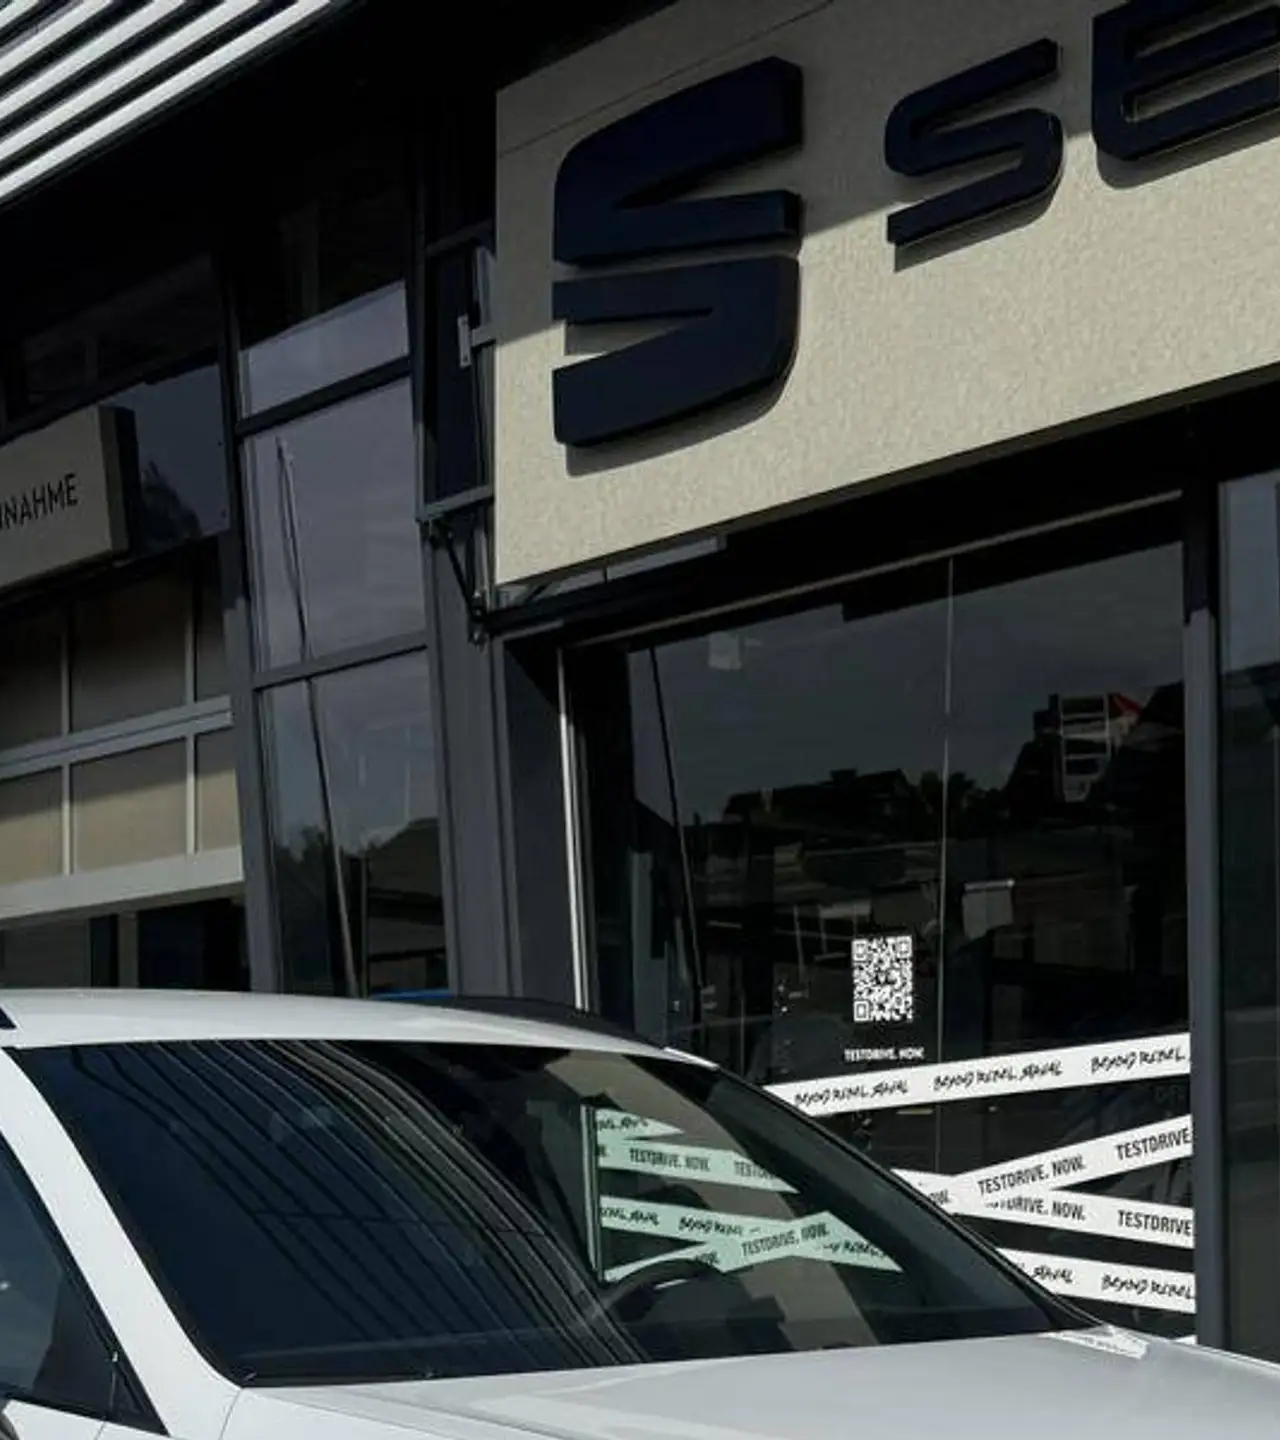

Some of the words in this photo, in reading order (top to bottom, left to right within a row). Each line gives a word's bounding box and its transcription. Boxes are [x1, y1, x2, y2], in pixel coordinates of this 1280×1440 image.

[977, 1162, 1049, 1196] TESTDRIVE.
[1051, 1154, 1087, 1178] NOW.
[1051, 1199, 1087, 1222] NOW.
